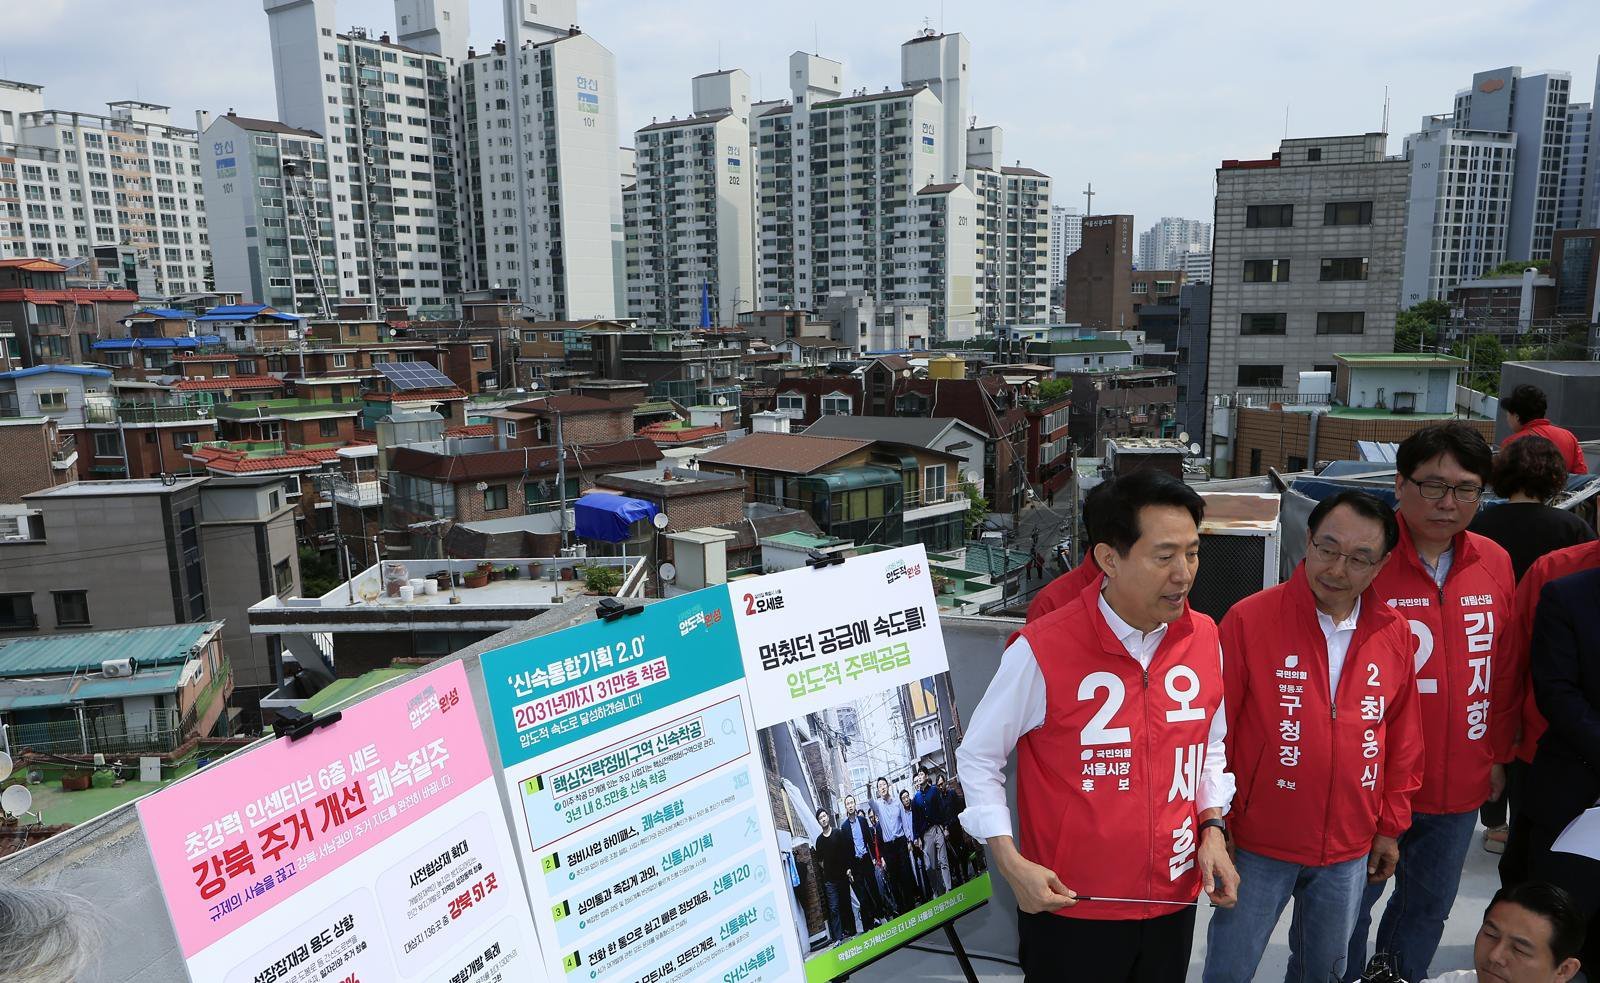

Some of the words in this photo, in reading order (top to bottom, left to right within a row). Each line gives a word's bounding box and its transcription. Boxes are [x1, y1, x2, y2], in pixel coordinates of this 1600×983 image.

[577, 76, 598, 91] 한신
[584, 117, 595, 127] 101
[922, 123, 935, 135] 한신
[213, 140, 234, 155] 한신
[223, 183, 233, 194] 101
[729, 176, 740, 185] 202
[959, 216, 967, 226] 201
[886, 566, 908, 584] 압도적
[907, 564, 921, 579] 완성
[743, 593, 756, 616] 2
[756, 596, 784, 613] 오세훈
[1398, 598, 1429, 607] 국민의힘
[1460, 595, 1493, 606] 대림신길
[678, 611, 705, 636] 압도적
[704, 608, 722, 629] 완성
[759, 634, 815, 671] 멈췄던
[818, 620, 871, 655] 공급에
[873, 606, 926, 638] 속도를!
[1408, 619, 1438, 694] 2
[787, 661, 840, 698] 압도적
[845, 642, 911, 680] 주택공급
[1275, 670, 1307, 680] 국민의힘
[1367, 663, 1380, 686] 2
[516, 687, 592, 726] 2031년까지
[597, 670, 638, 698] 31만호
[641, 660, 666, 682] 착공
[1278, 684, 1303, 693] 영등포
[409, 694, 440, 730] 압도적
[439, 687, 460, 714] 완성
[520, 727, 548, 747] 압도적
[550, 716, 578, 736] 속도로
[581, 693, 640, 724] 달성하겠습니다!
[1077, 671, 1131, 745] 2
[1279, 696, 1302, 767] 구청장
[1360, 695, 1385, 791] 최웅식
[555, 742, 651, 794] 핵심전략정비구역
[656, 721, 701, 752] 신속착공
[1096, 749, 1131, 758] 국민의힘
[1081, 762, 1130, 776] 서울시장
[1164, 664, 1206, 881] 오세훈
[528, 781, 533, 790] 1
[564, 806, 582, 823] 3년
[582, 801, 594, 814] 내
[595, 786, 627, 809] 8.5만호
[629, 778, 648, 794] 신속
[648, 769, 666, 785] 착공
[1276, 779, 1296, 790] 후보
[183, 812, 242, 859] 초강력
[245, 775, 316, 827] 인센티브
[316, 759, 347, 791] 6종
[346, 743, 379, 775] 세트
[192, 841, 255, 900] 강북
[256, 810, 312, 865] 주거
[313, 781, 366, 832] 개선
[366, 739, 449, 803] 쾌속질주
[567, 841, 601, 866] 정비사업
[603, 824, 638, 850] 하이패스,
[641, 799, 684, 831] 쾌속통합
[208, 893, 242, 921] 규제의
[242, 874, 274, 902] 사슬을
[275, 862, 295, 883] 끊고
[352, 818, 372, 837] 주거
[372, 803, 396, 826] 지도를
[408, 852, 450, 887] 사전협상제
[450, 839, 469, 859] 확대
[544, 859, 551, 869] 2
[577, 888, 611, 915] 심의통과
[613, 875, 638, 896] 족집게
[639, 864, 658, 883] 과외,
[660, 834, 712, 870] 신통AI기획
[404, 933, 423, 953] 대상지
[448, 890, 472, 920] 강북
[483, 872, 498, 893] 곳
[555, 907, 561, 917] 3
[588, 947, 606, 966] 전화
[607, 941, 617, 955] 한
[618, 927, 642, 949] 통으로
[643, 917, 660, 934] 쉽고
[660, 908, 678, 925] 빠른
[678, 889, 710, 916] 정보제공,
[713, 863, 749, 895] 신통120
[310, 929, 333, 953] 용도
[333, 914, 354, 938] 상향
[676, 937, 717, 967] 모든단계로,
[719, 907, 757, 940] 신통확산
[484, 942, 501, 962] 특례
[566, 958, 572, 967] 4
